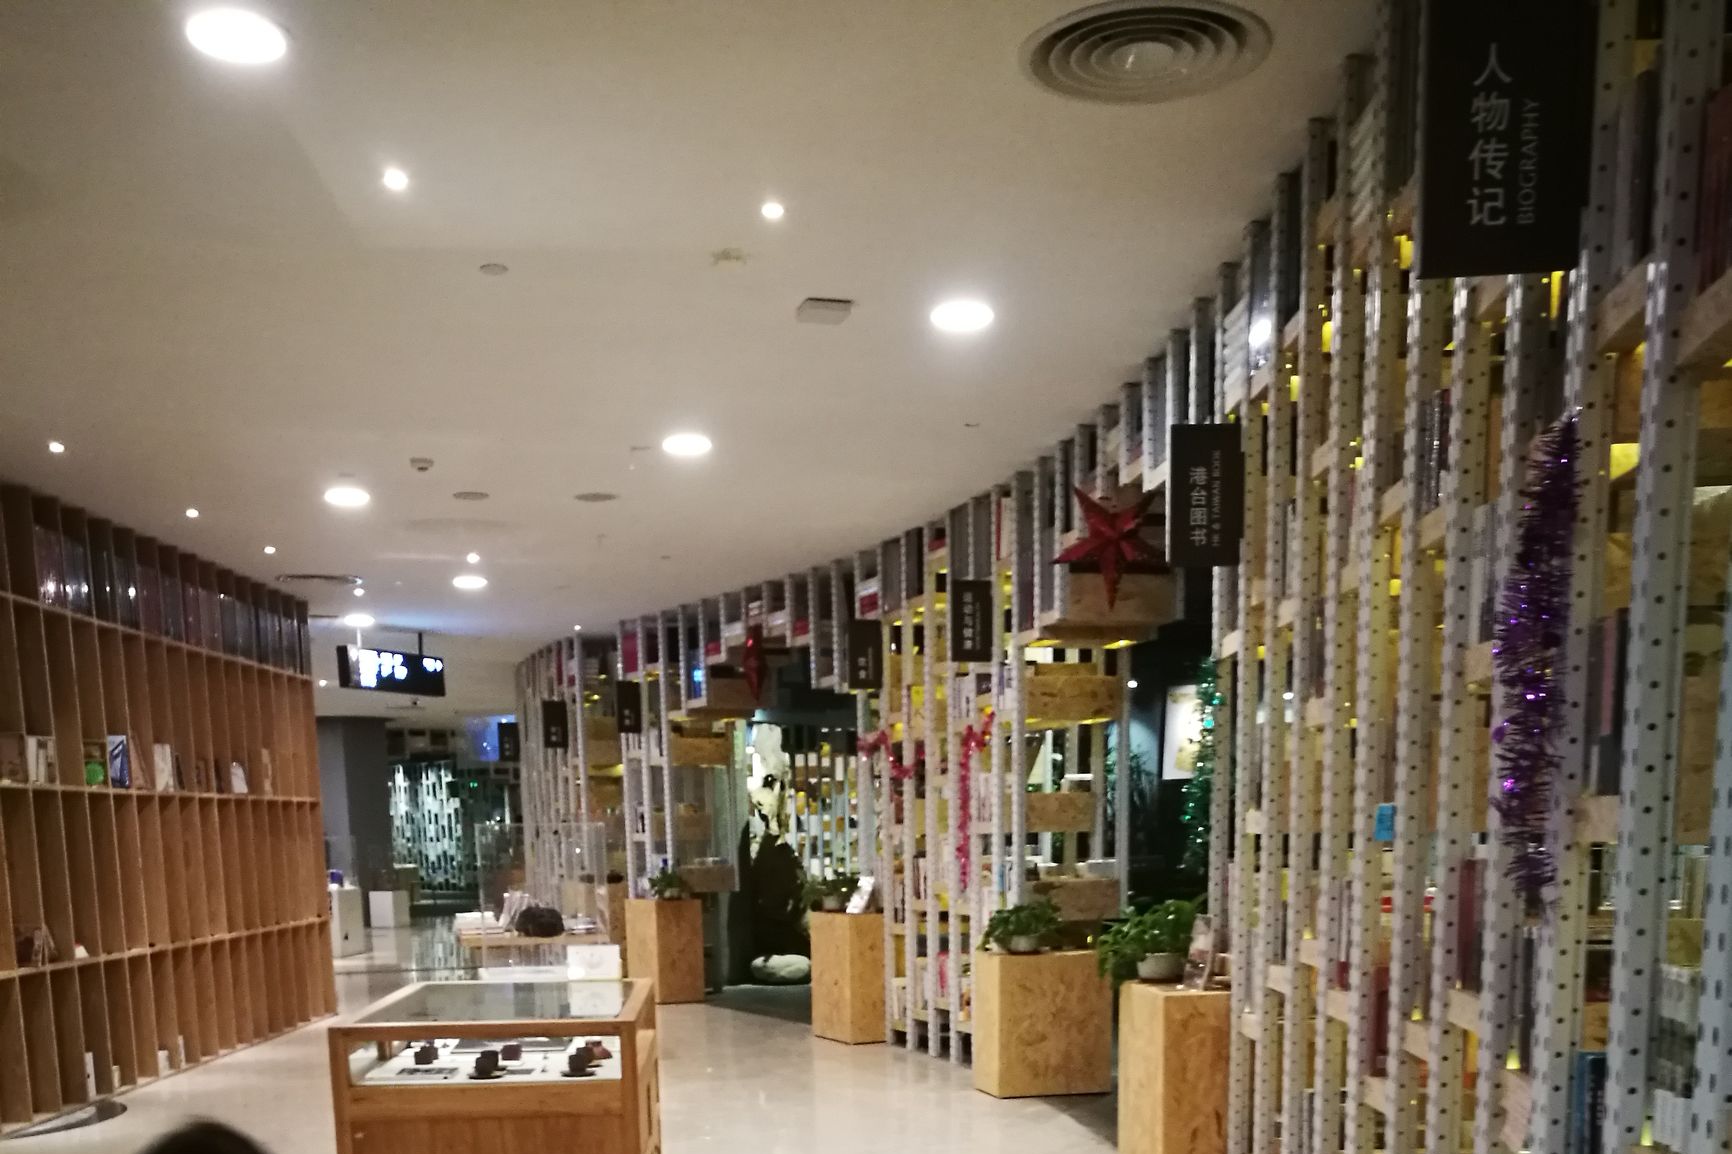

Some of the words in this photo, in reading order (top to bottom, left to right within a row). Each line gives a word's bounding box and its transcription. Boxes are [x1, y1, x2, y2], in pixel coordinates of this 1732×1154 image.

[1466, 42, 1512, 226] 人物传记
[1516, 98, 1540, 225] BIOGRAPHY
[1189, 466, 1208, 546] 港台图书
[1211, 480, 1221, 519] TAIWAN
